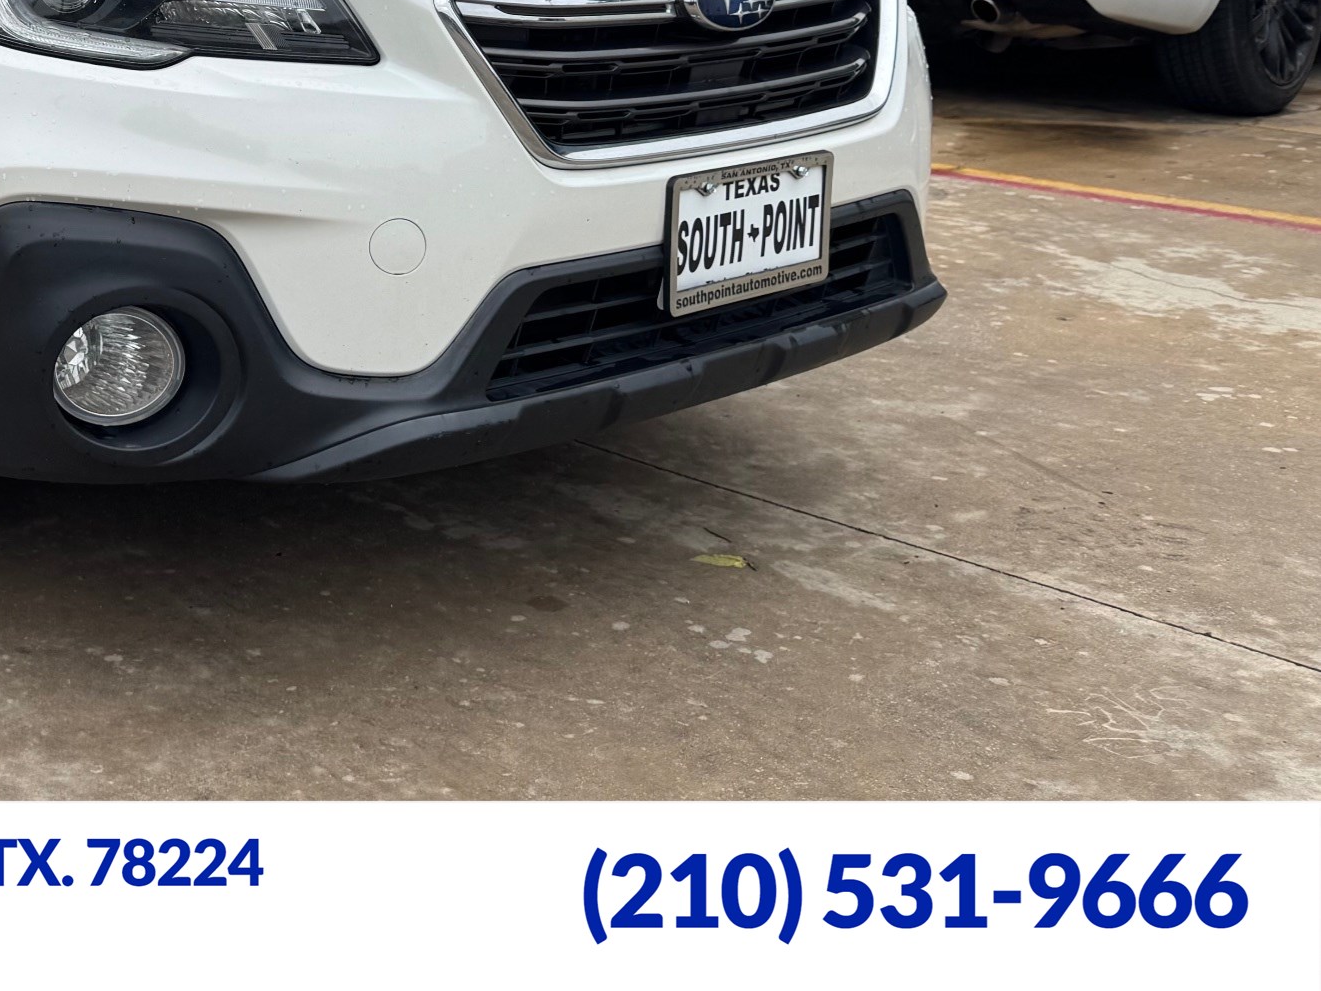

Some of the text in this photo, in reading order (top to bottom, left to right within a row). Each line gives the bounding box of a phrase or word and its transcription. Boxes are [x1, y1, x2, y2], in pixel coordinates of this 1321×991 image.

[721, 170, 738, 180] SAN
[723, 173, 780, 201] TEXAS
[676, 264, 823, 309] southpointautomotive.com
